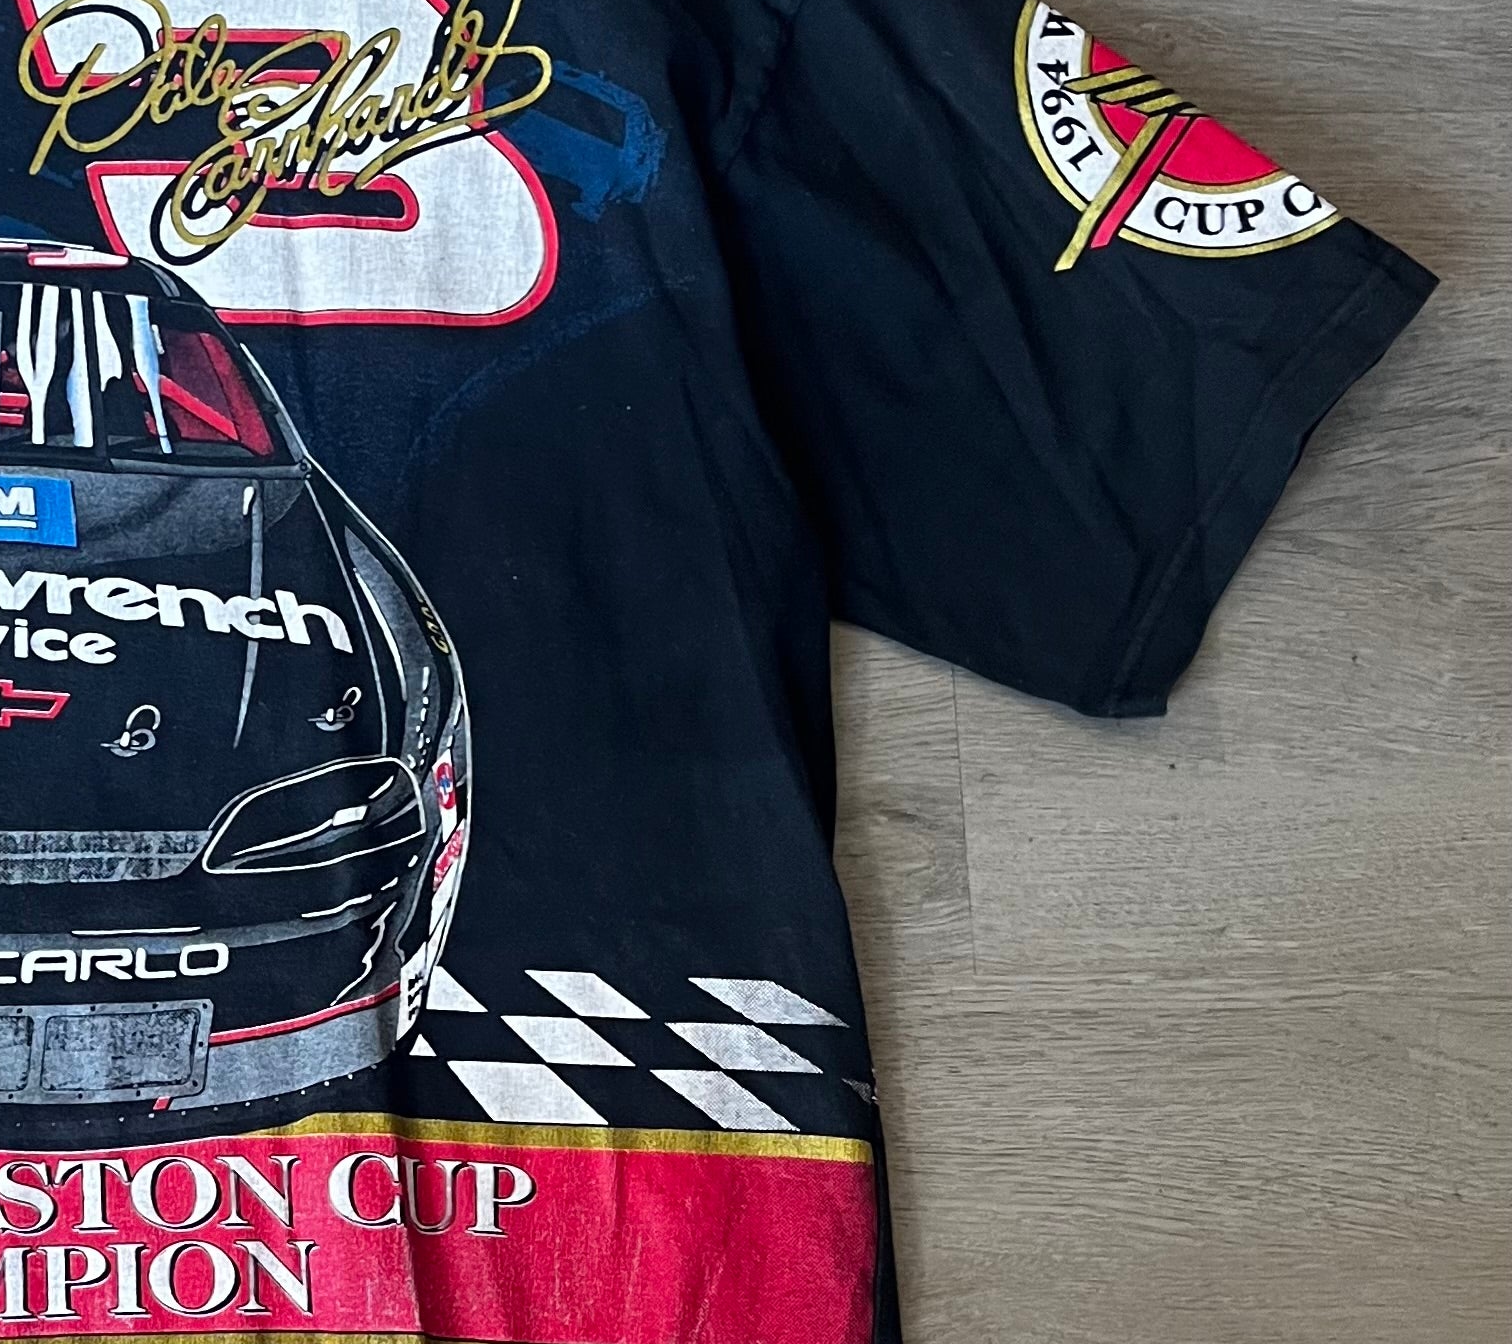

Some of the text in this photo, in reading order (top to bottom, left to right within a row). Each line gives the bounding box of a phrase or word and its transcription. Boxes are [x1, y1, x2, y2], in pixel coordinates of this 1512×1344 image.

[1036, 59, 1104, 172] 1994
[1154, 196, 1264, 236] CUP
[328, 1151, 538, 1240] CUP
